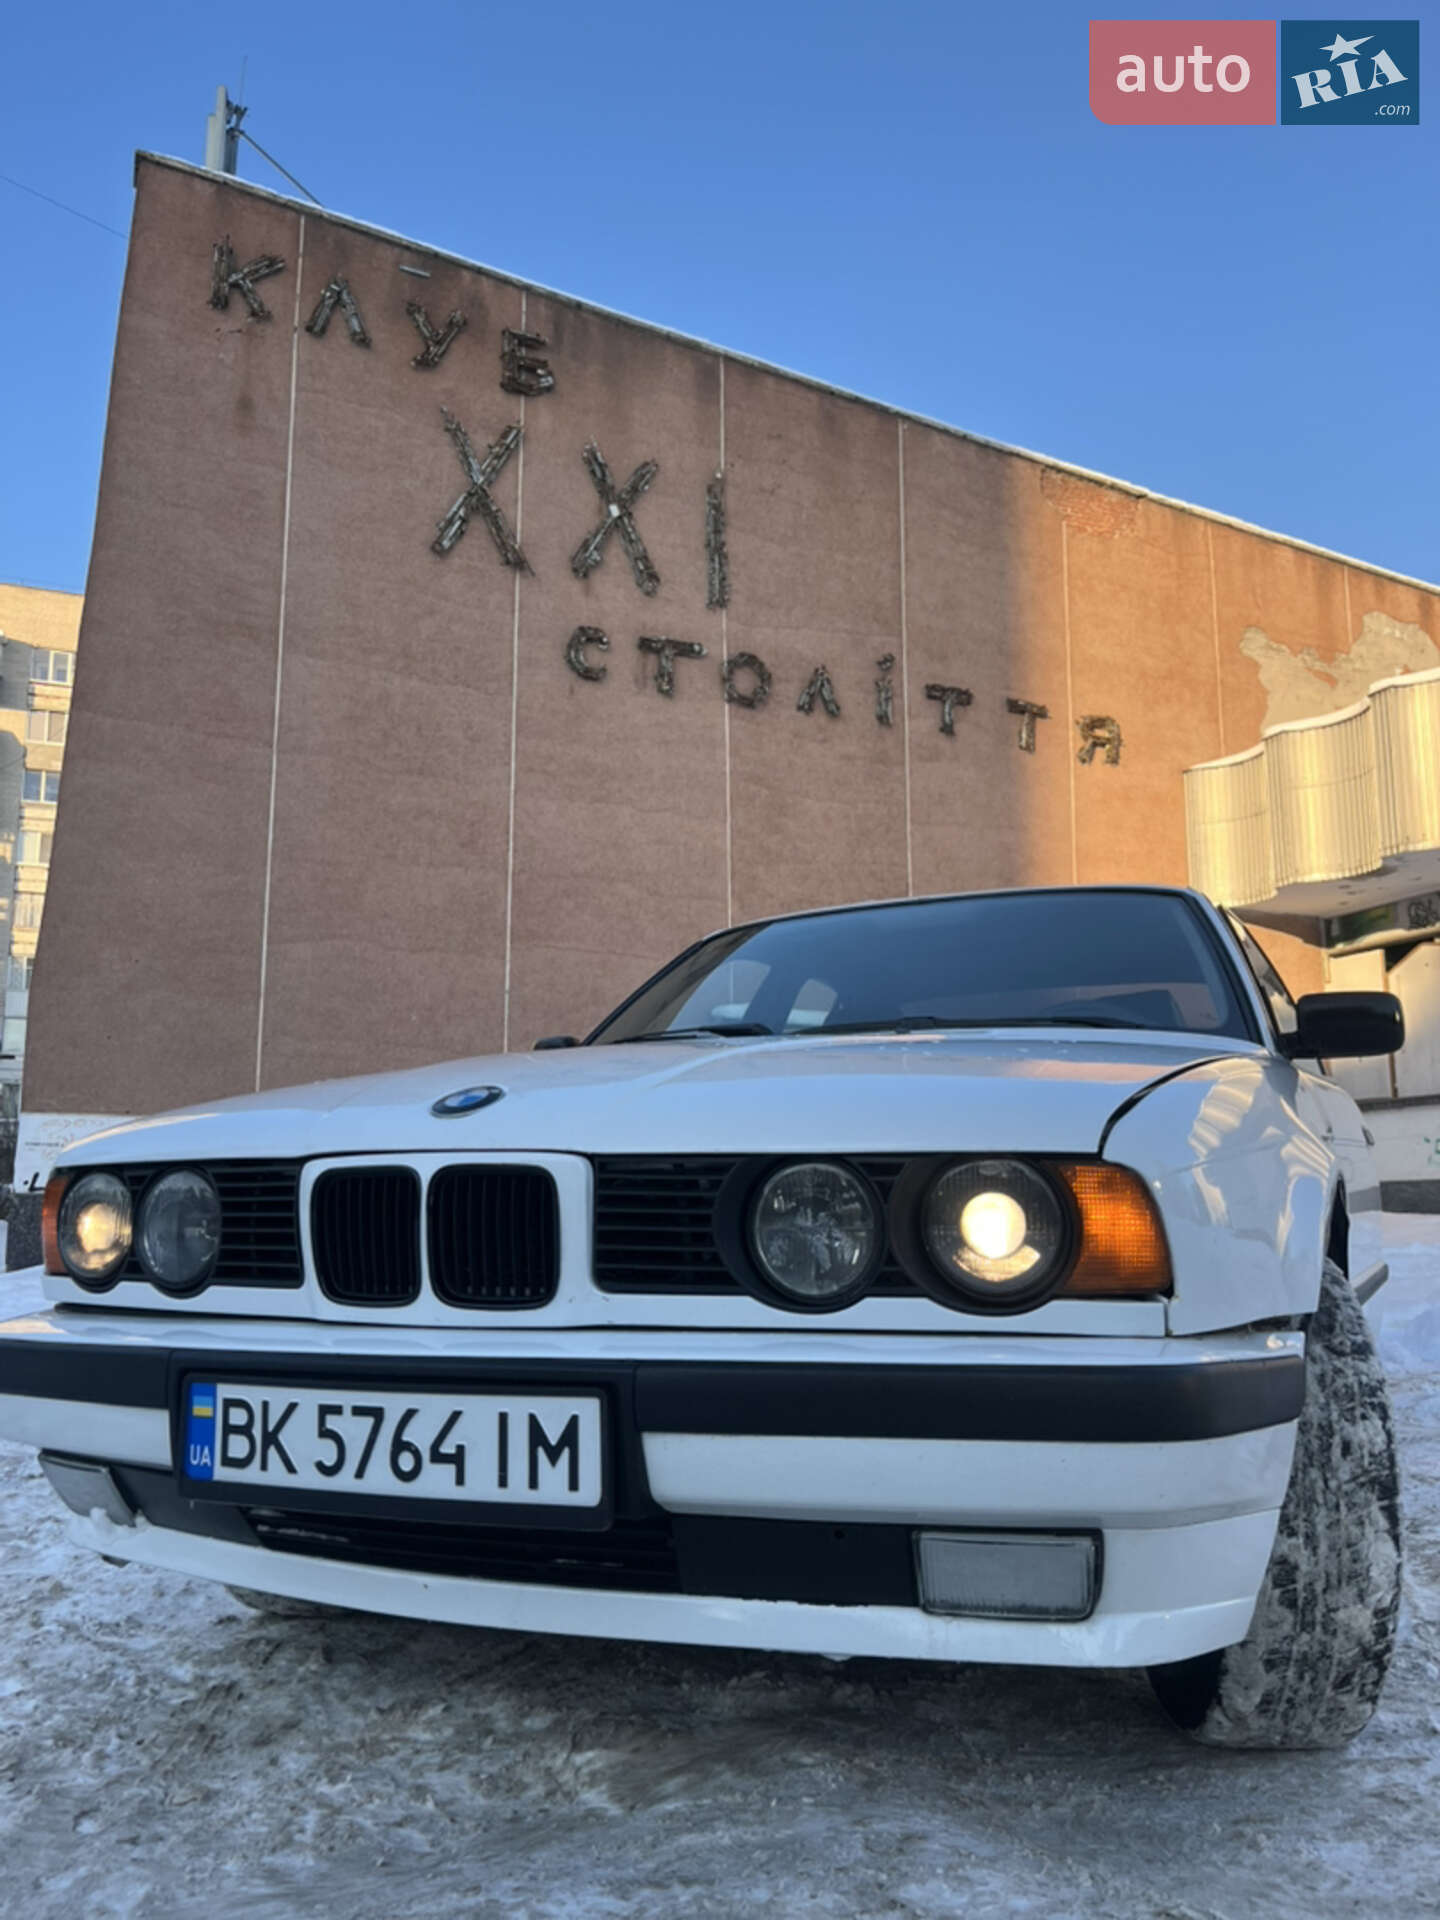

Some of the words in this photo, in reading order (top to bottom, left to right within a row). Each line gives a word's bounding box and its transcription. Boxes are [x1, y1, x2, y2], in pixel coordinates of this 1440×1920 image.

[209, 234, 556, 396] КЛУБ
[189, 1445, 212, 1466] UA
[314, 1404, 466, 1487] 5764
